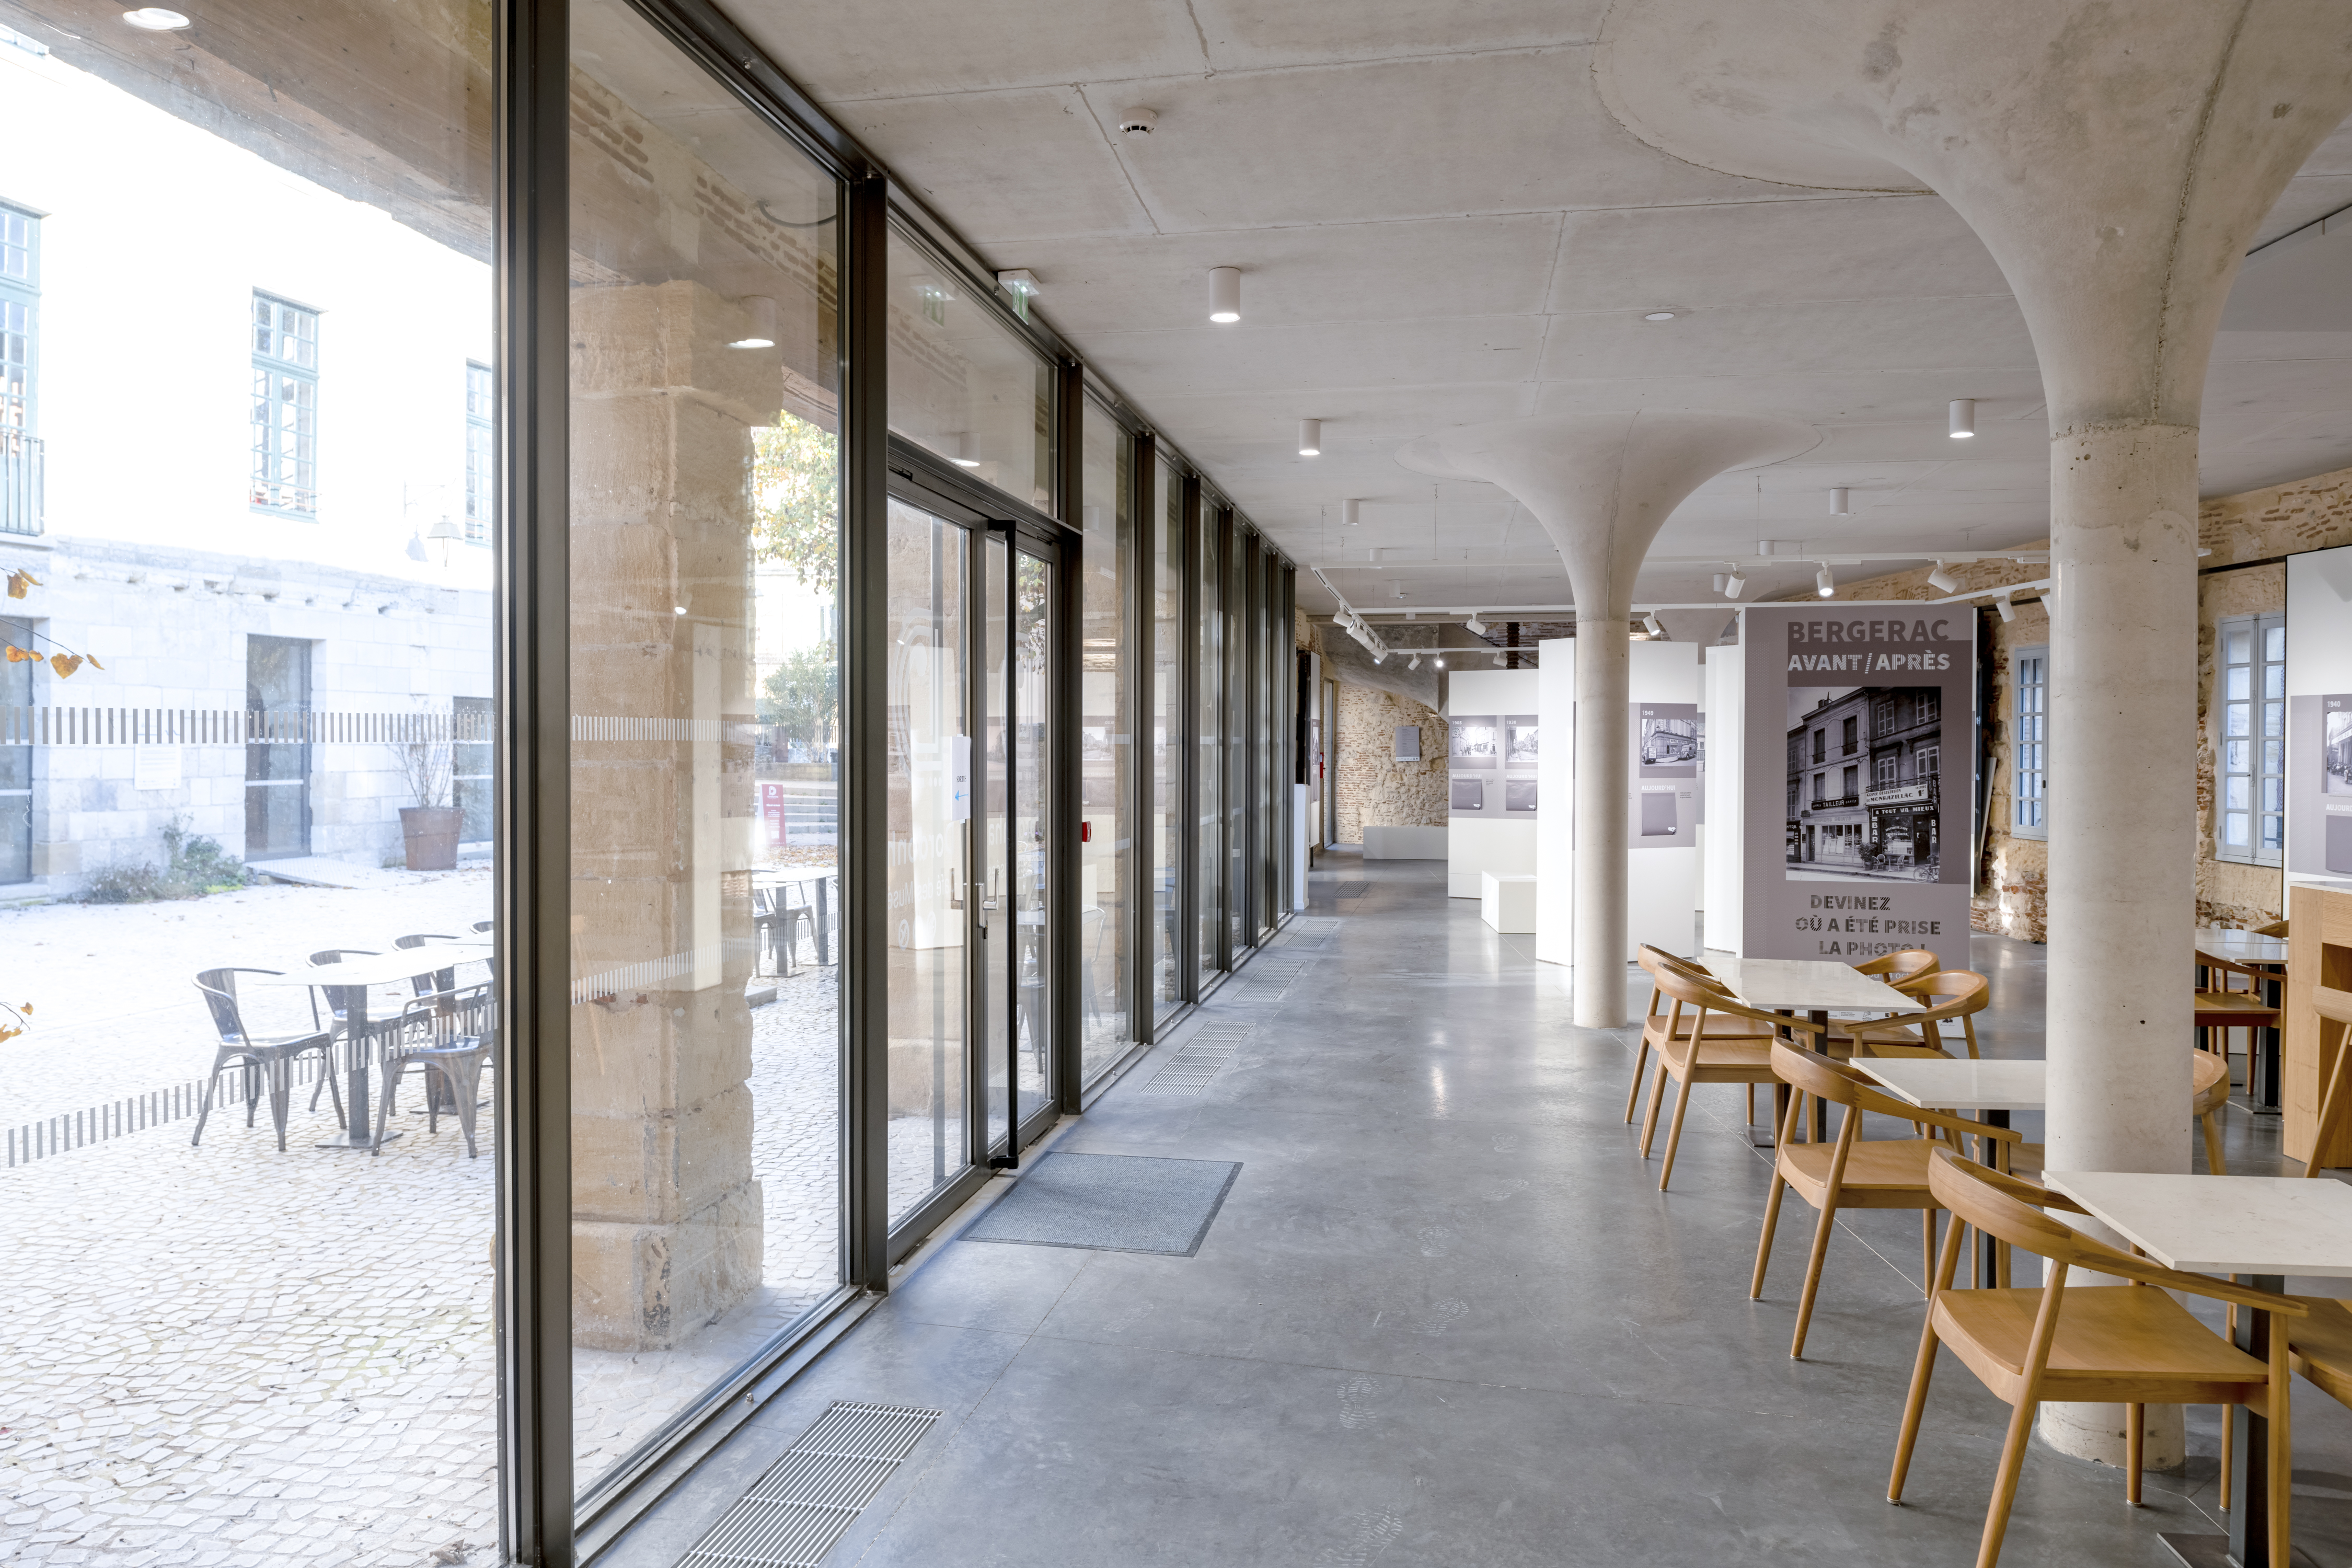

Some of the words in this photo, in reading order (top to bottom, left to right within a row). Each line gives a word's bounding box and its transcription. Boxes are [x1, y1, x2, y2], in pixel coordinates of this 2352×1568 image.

[1788, 619, 1949, 642] BERGERAC
[1871, 792, 1913, 801] MONBAZILLAC
[1811, 895, 1890, 910] DEVINEZ
[1795, 915, 1822, 931] OÙ
[1827, 918, 1840, 932] A
[1845, 915, 1879, 933] ÉTÉ
[1885, 920, 1941, 935] PRISE
[1819, 941, 1841, 955] LA
